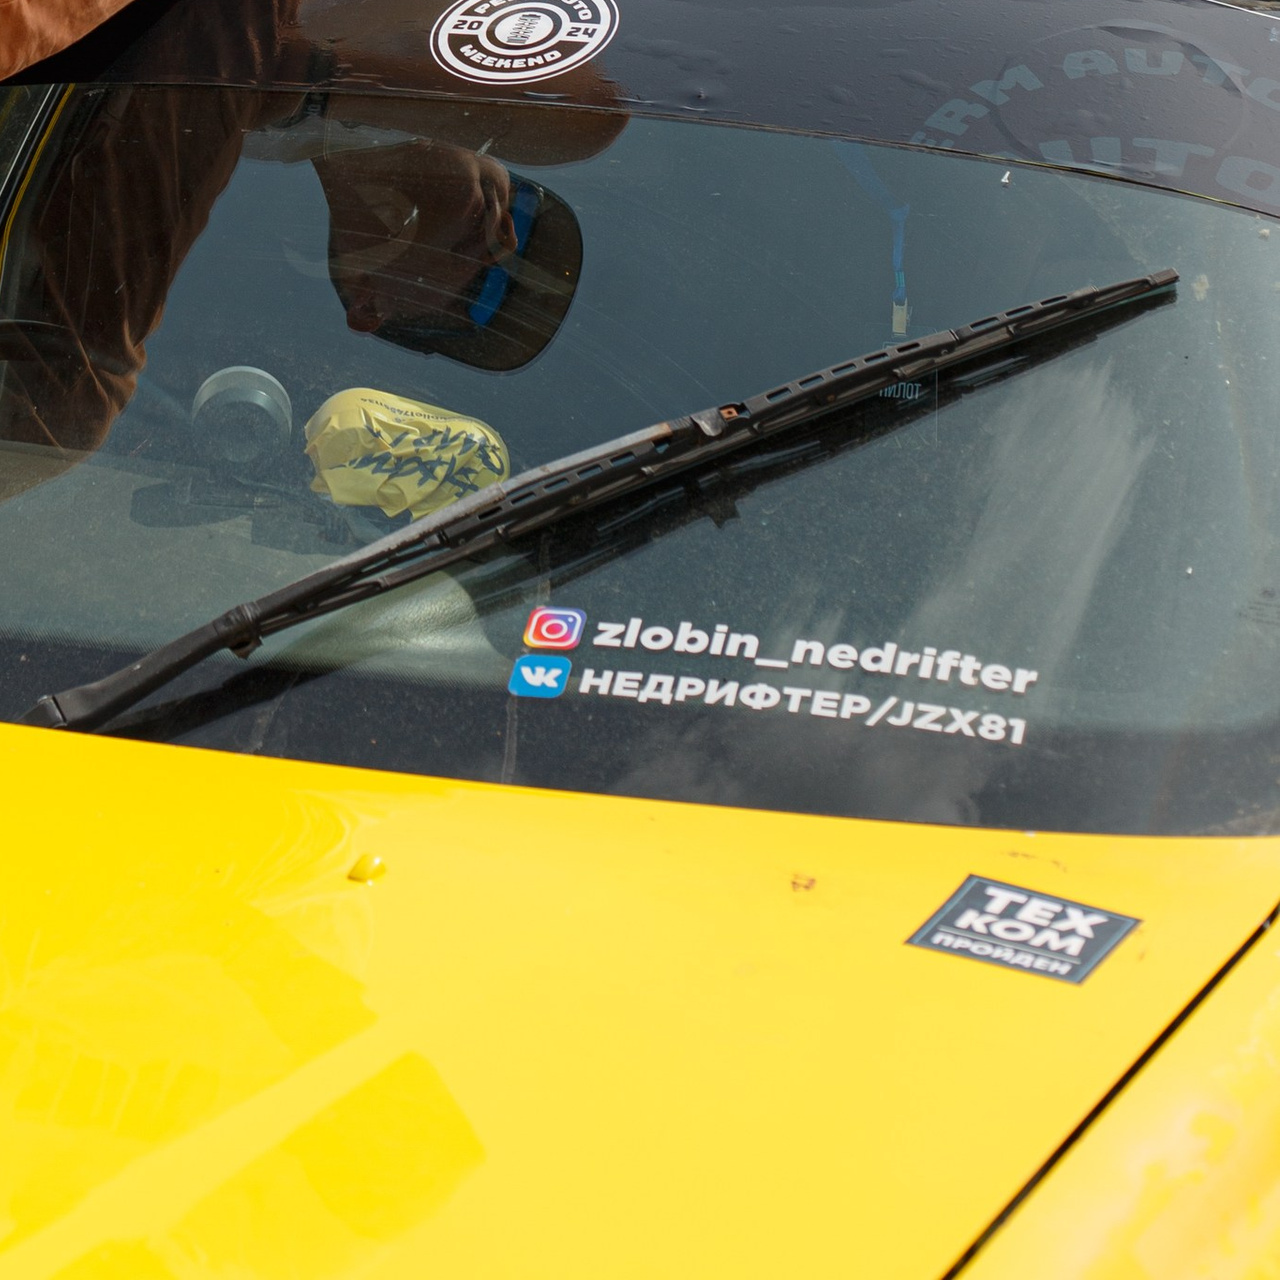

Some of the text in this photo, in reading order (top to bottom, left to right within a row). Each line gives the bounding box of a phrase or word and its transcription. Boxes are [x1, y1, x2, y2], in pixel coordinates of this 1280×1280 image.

[452, 19, 598, 38] 20 24
[459, 43, 563, 69] WEEKEND
[592, 617, 1039, 694] zlobin_nedrifter
[578, 667, 1027, 745] НЕДРИФТЕР/JZX81
[954, 908, 1087, 957] КОМ
[983, 885, 1109, 939] ТЕХ
[931, 931, 1074, 976] ПРОЙДЕН
